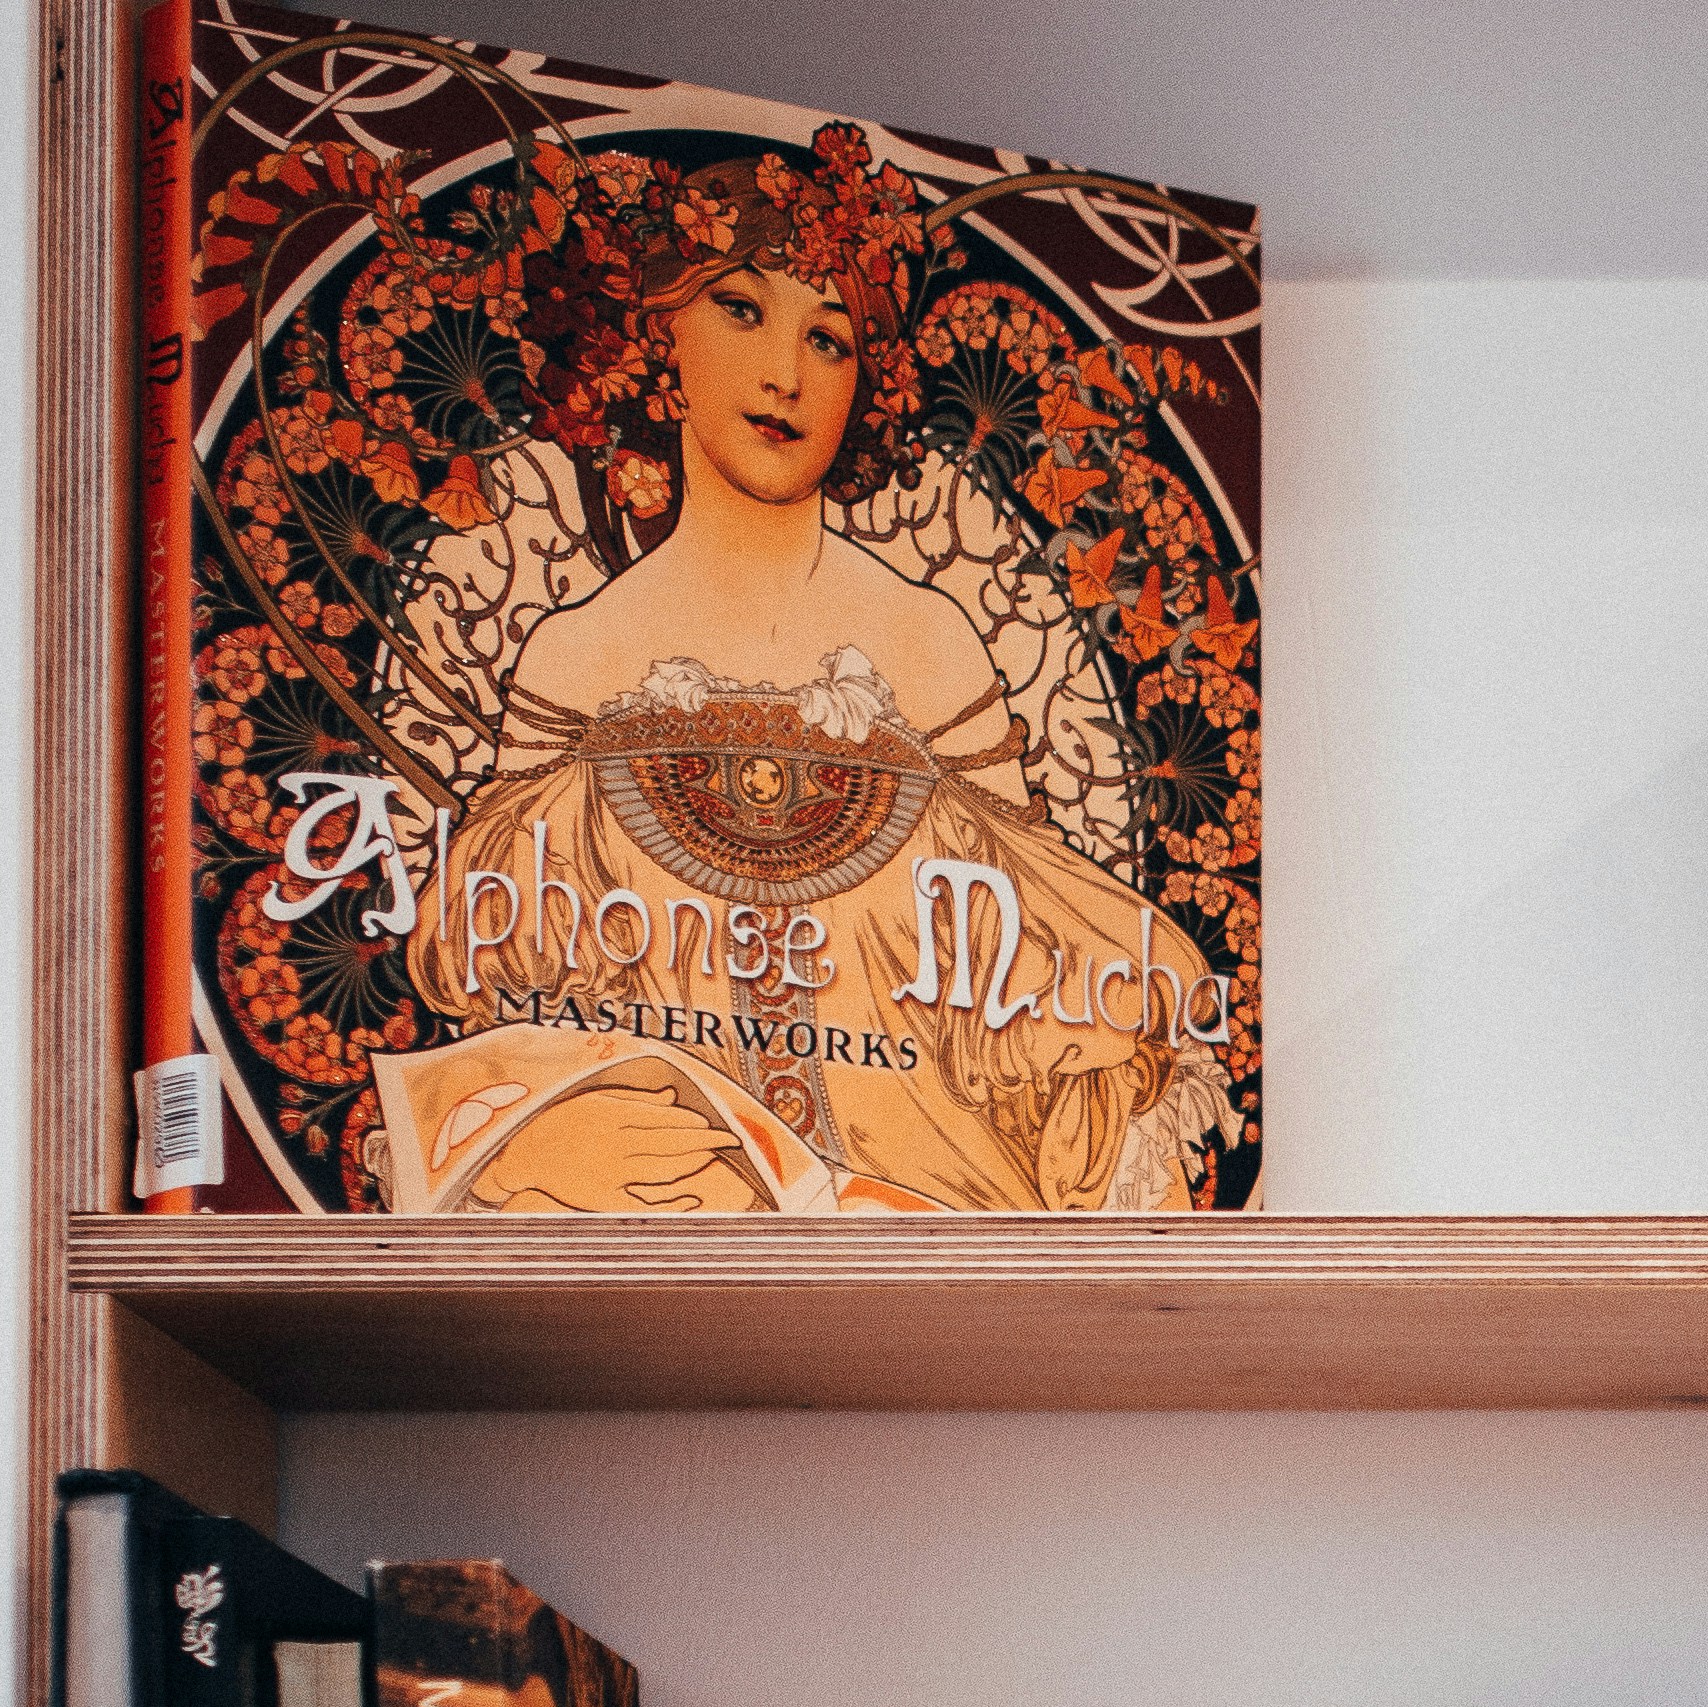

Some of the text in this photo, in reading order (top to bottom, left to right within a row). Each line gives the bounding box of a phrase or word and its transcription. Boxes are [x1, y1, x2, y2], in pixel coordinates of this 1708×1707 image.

[146, 519, 168, 877] MASTERWORKS
[262, 771, 1235, 1051] Alphonse Mucha
[494, 984, 922, 1073] MASTERWORKS
